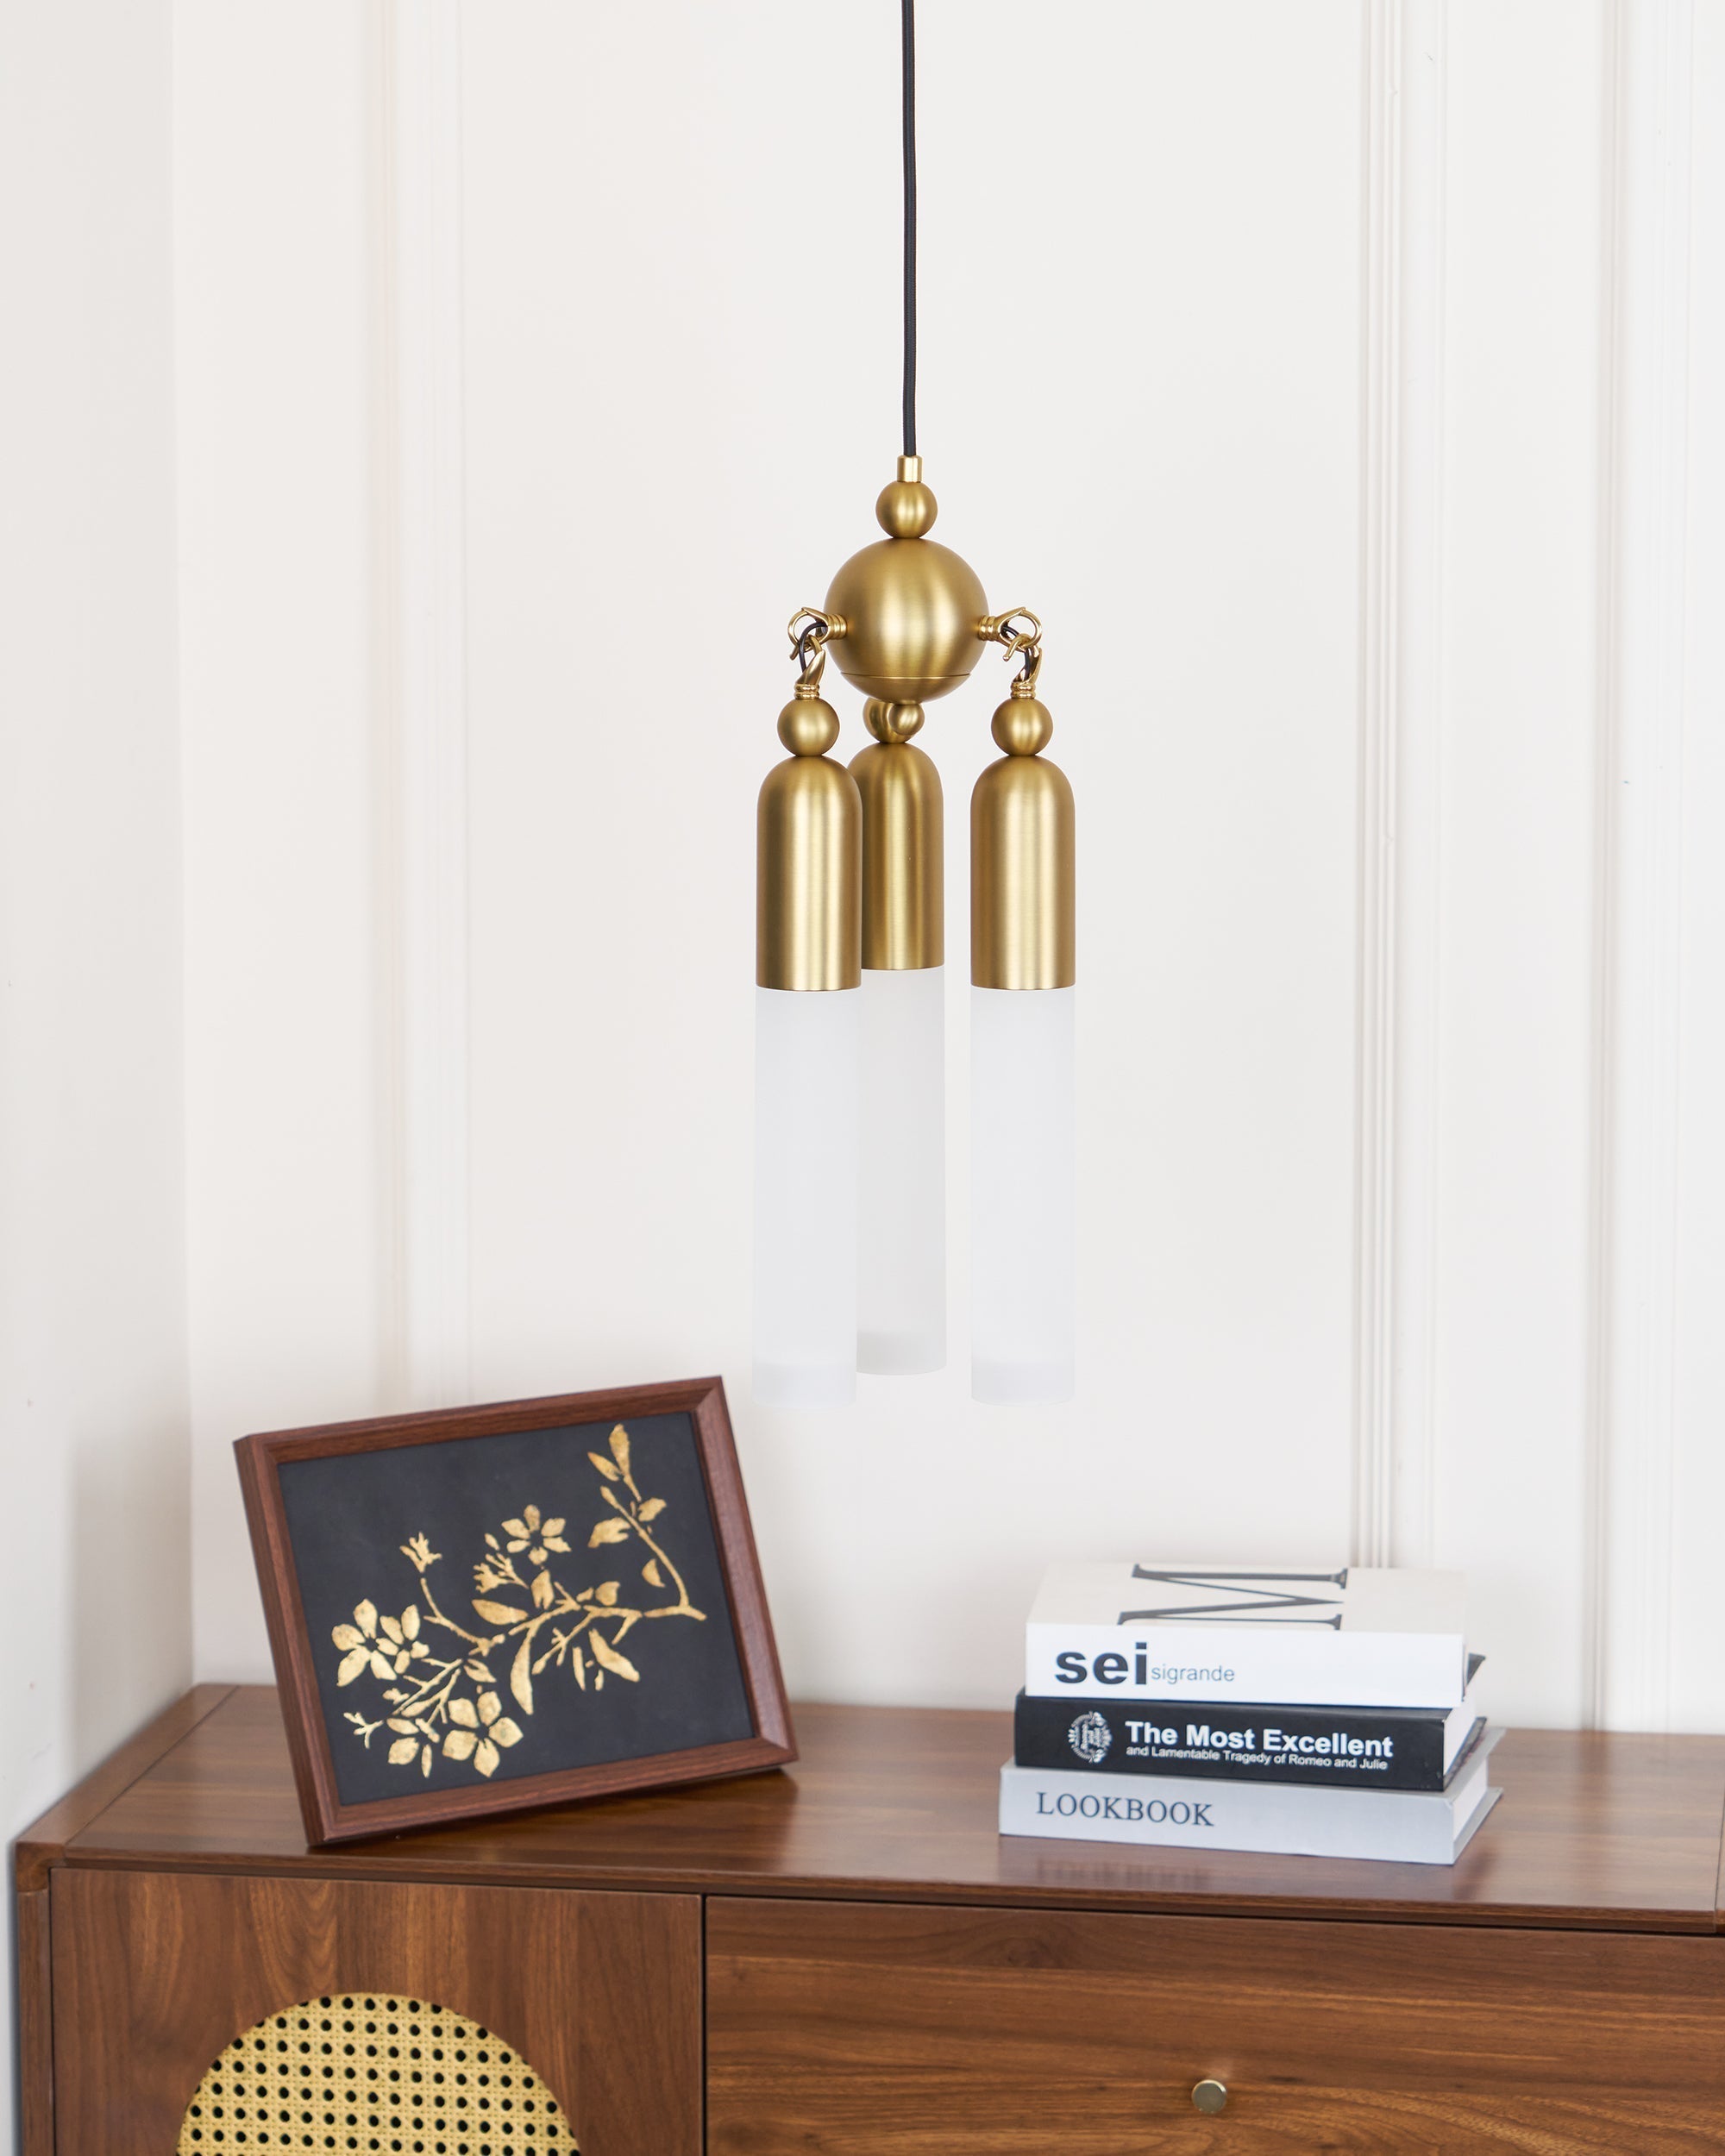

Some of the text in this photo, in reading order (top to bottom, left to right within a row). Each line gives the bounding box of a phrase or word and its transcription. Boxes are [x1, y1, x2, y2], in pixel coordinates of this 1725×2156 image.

[1055, 1641, 1235, 1685] sei sigrande
[1125, 1720, 1178, 1745] The
[1186, 1724, 1255, 1749] Most
[1263, 1728, 1394, 1758] Excellent
[1126, 1745, 1150, 1756] and
[1151, 1746, 1220, 1760] Lamentable
[1223, 1750, 1271, 1764] Tragedy
[1273, 1752, 1287, 1764] of
[1289, 1754, 1332, 1766] Romeo
[1334, 1758, 1358, 1769] and
[1036, 1792, 1214, 1827] LOOKBOOK
